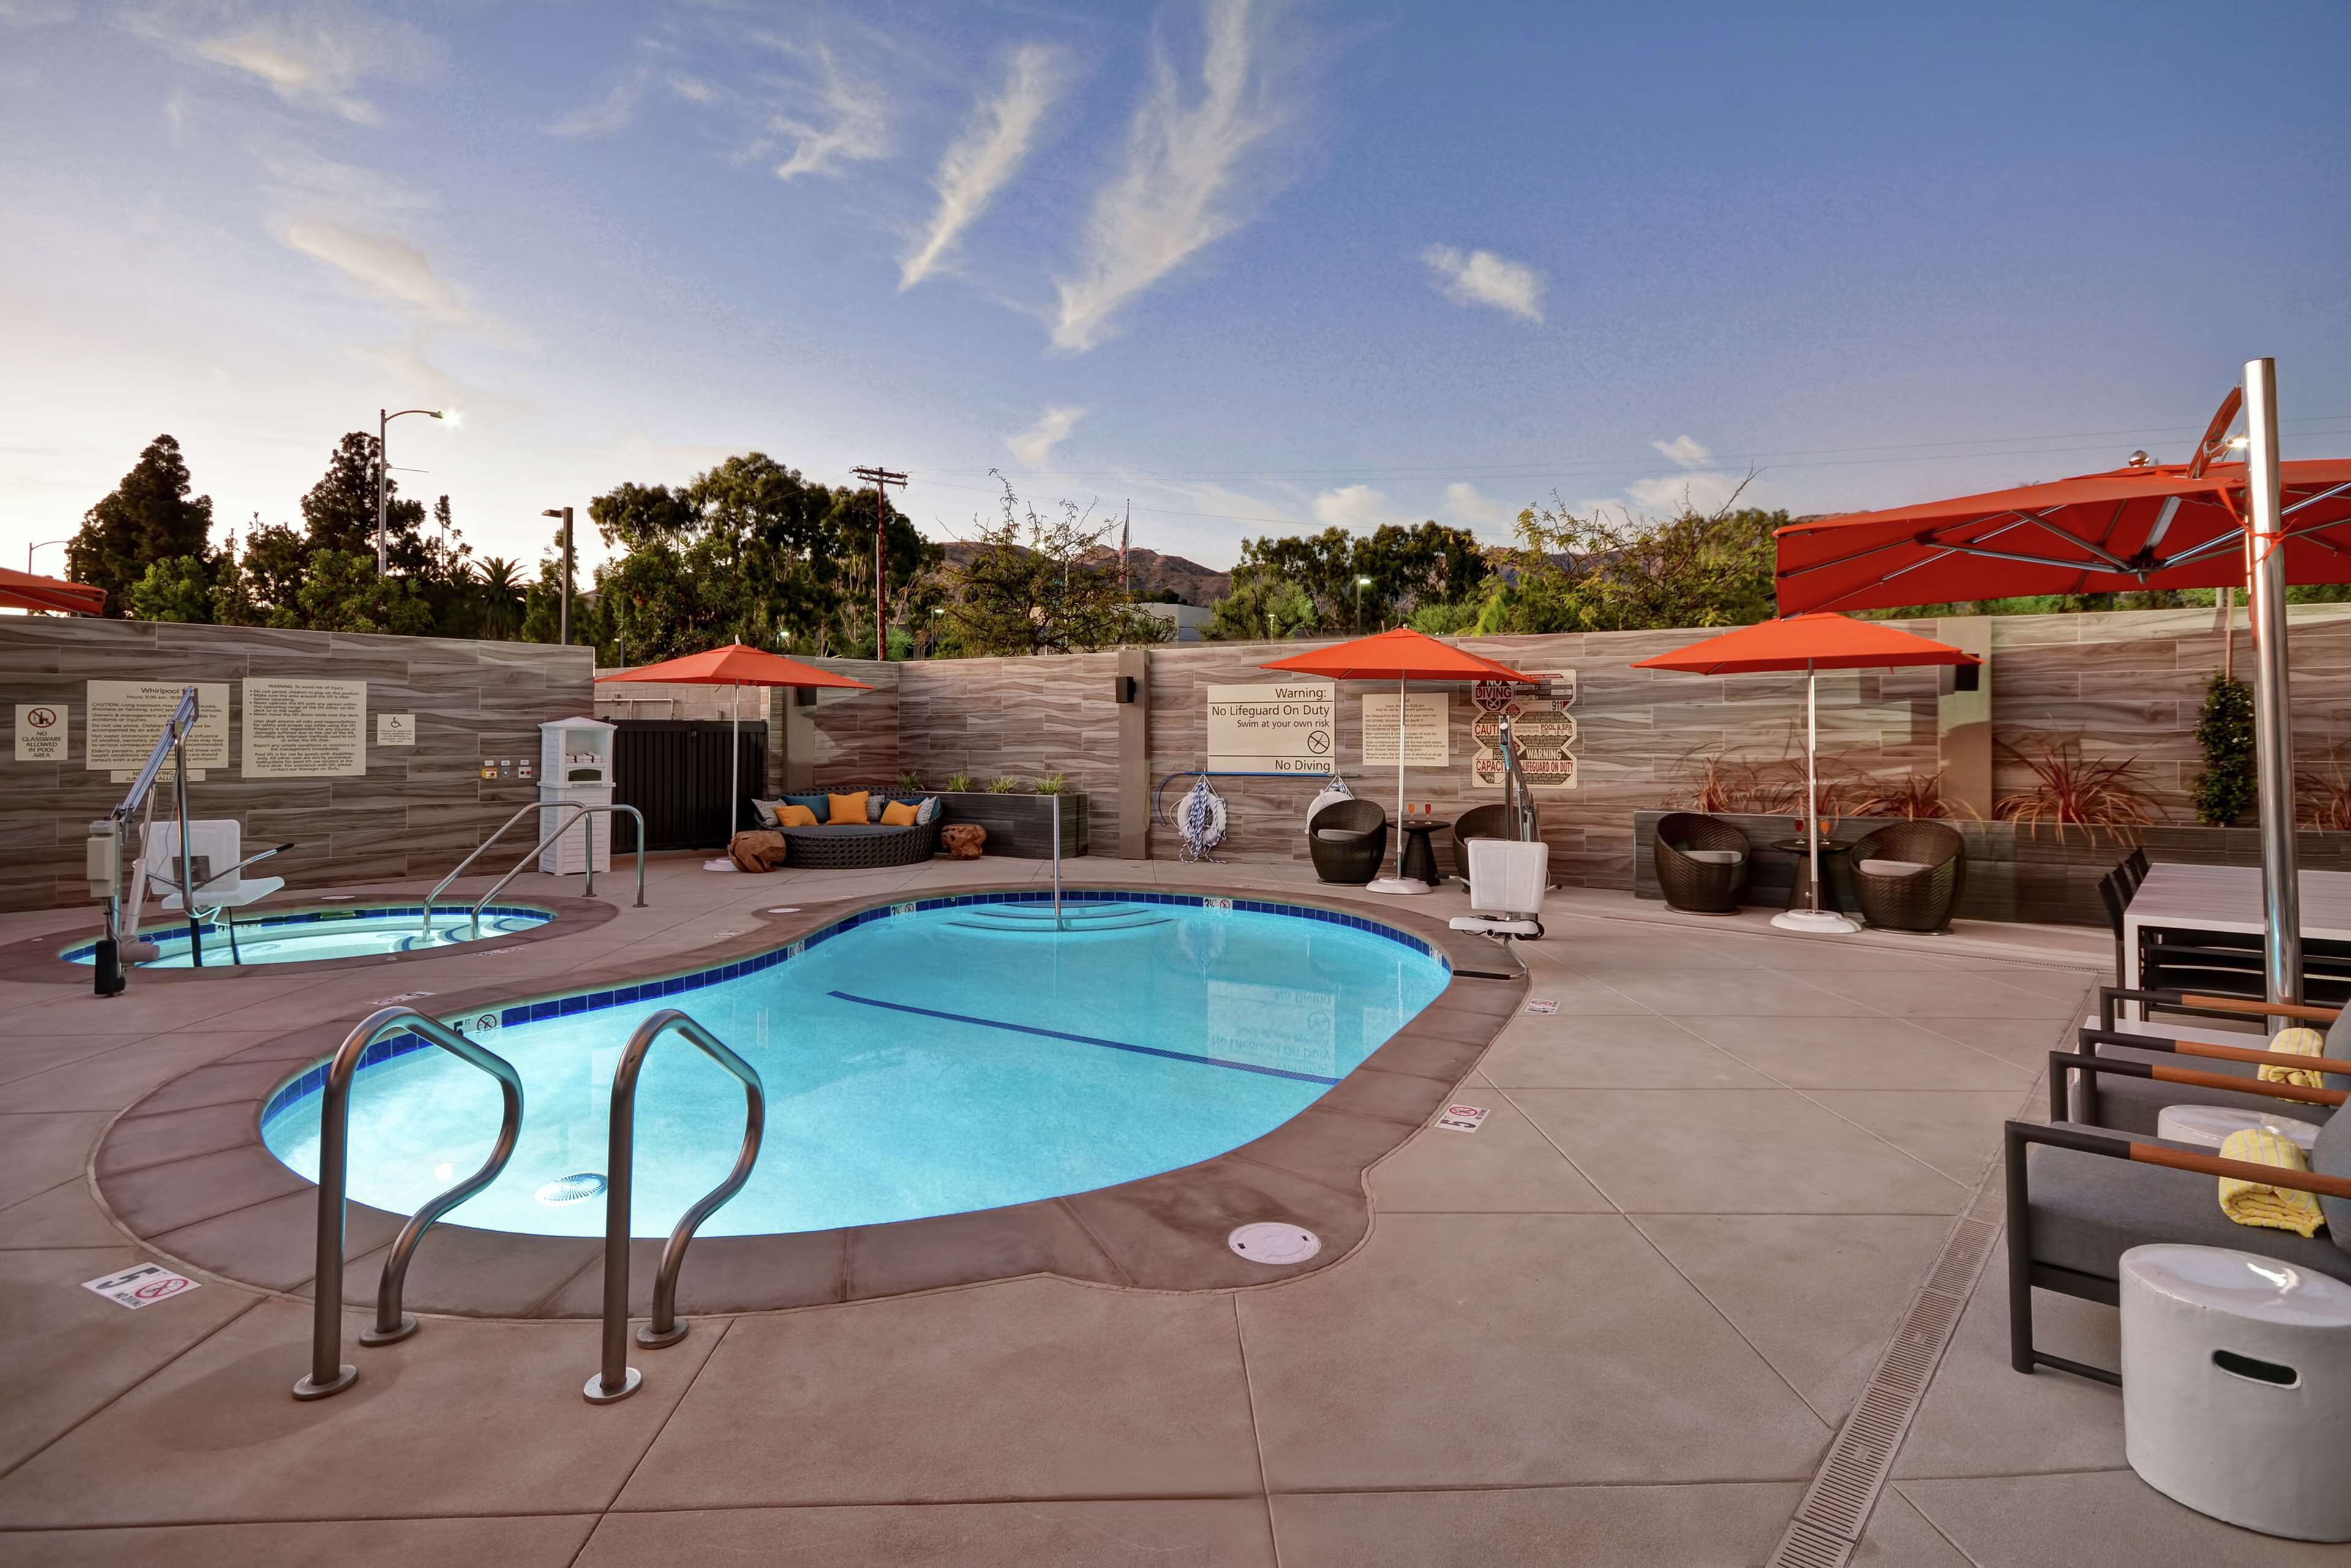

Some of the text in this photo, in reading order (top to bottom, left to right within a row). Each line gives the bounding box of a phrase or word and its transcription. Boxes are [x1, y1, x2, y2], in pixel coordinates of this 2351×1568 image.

[1275, 688, 1326, 700] Warning:
[1475, 687, 1512, 699] DIVING
[1552, 700, 1562, 710] 911
[1212, 705, 1330, 718] No Lifeguard On Duty
[1237, 719, 1258, 728] Swim
[1272, 721, 1291, 729] your
[1315, 719, 1330, 727] risk
[1525, 749, 1562, 760] WARNING
[1275, 759, 1330, 773] No Diving
[1476, 760, 1505, 771] CAPACI
[1551, 761, 1558, 772] ON
[1560, 761, 1573, 773] DUTY
[96, 1267, 160, 1289] 5
